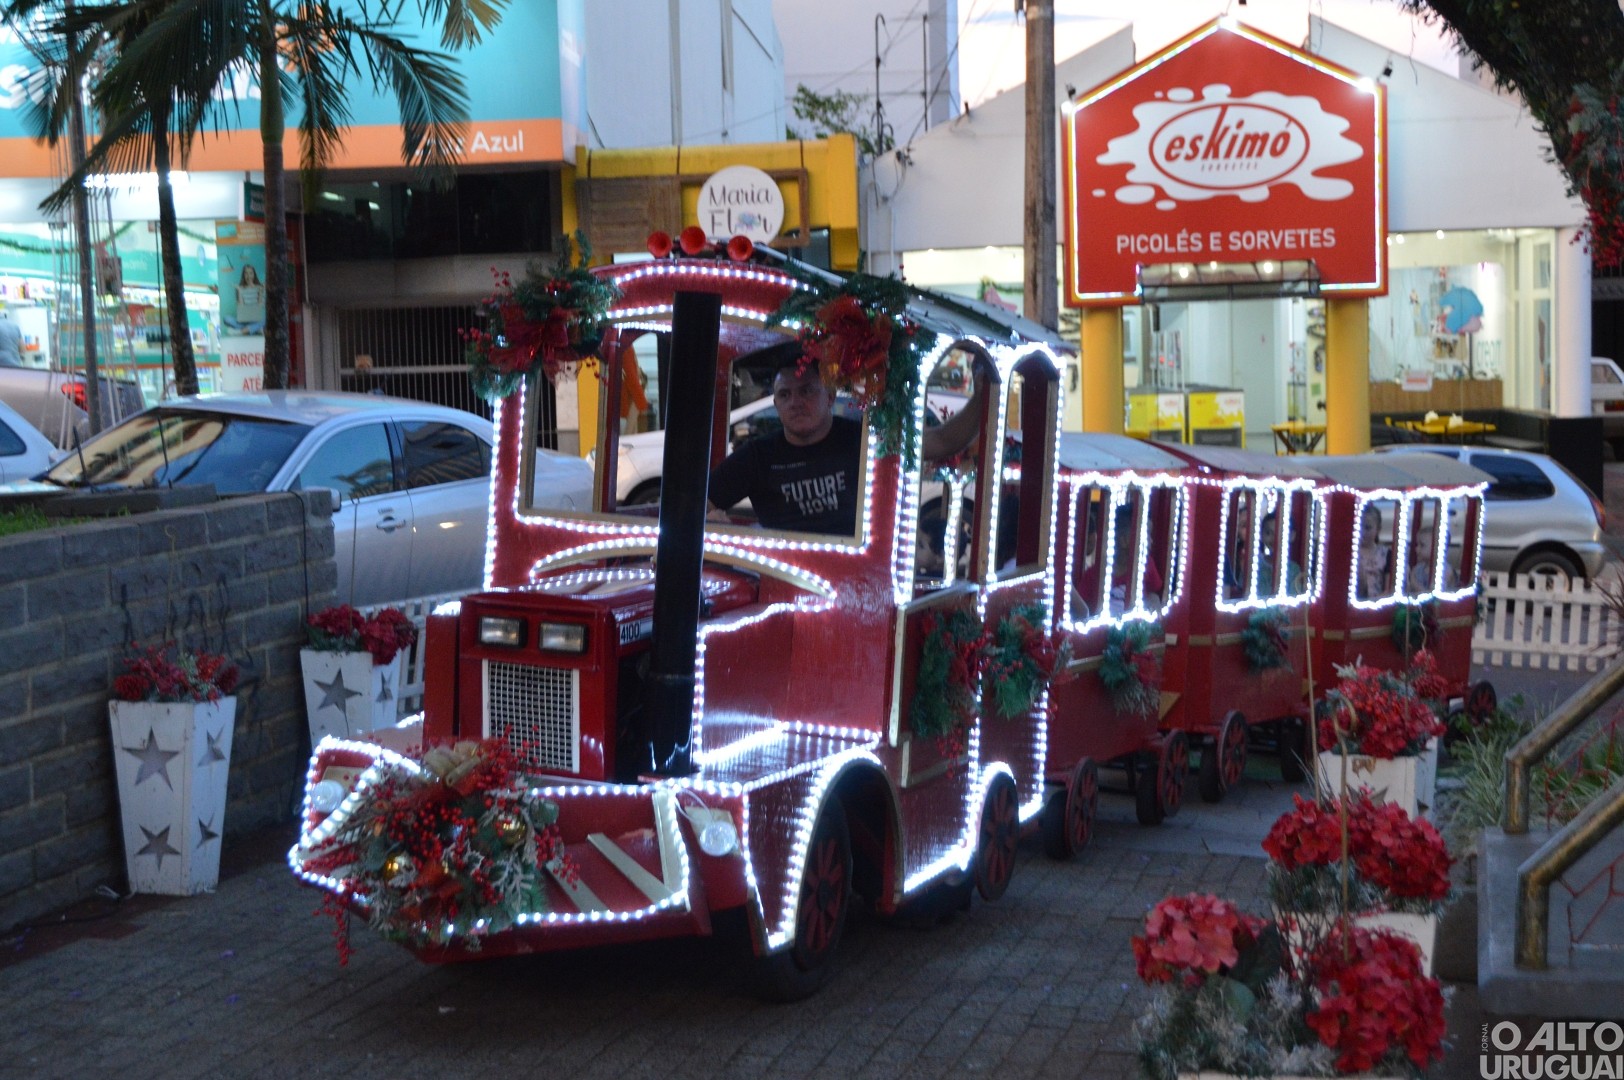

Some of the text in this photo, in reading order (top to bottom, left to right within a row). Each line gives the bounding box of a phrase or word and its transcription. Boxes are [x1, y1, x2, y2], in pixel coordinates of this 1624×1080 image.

[471, 130, 523, 153] Azul
[709, 184, 773, 206] Maria
[1116, 228, 1336, 254] PICOLÉS E SORVETES
[780, 470, 846, 502] FUTURE
[798, 493, 838, 515] NOW
[620, 622, 640, 642] 4100
